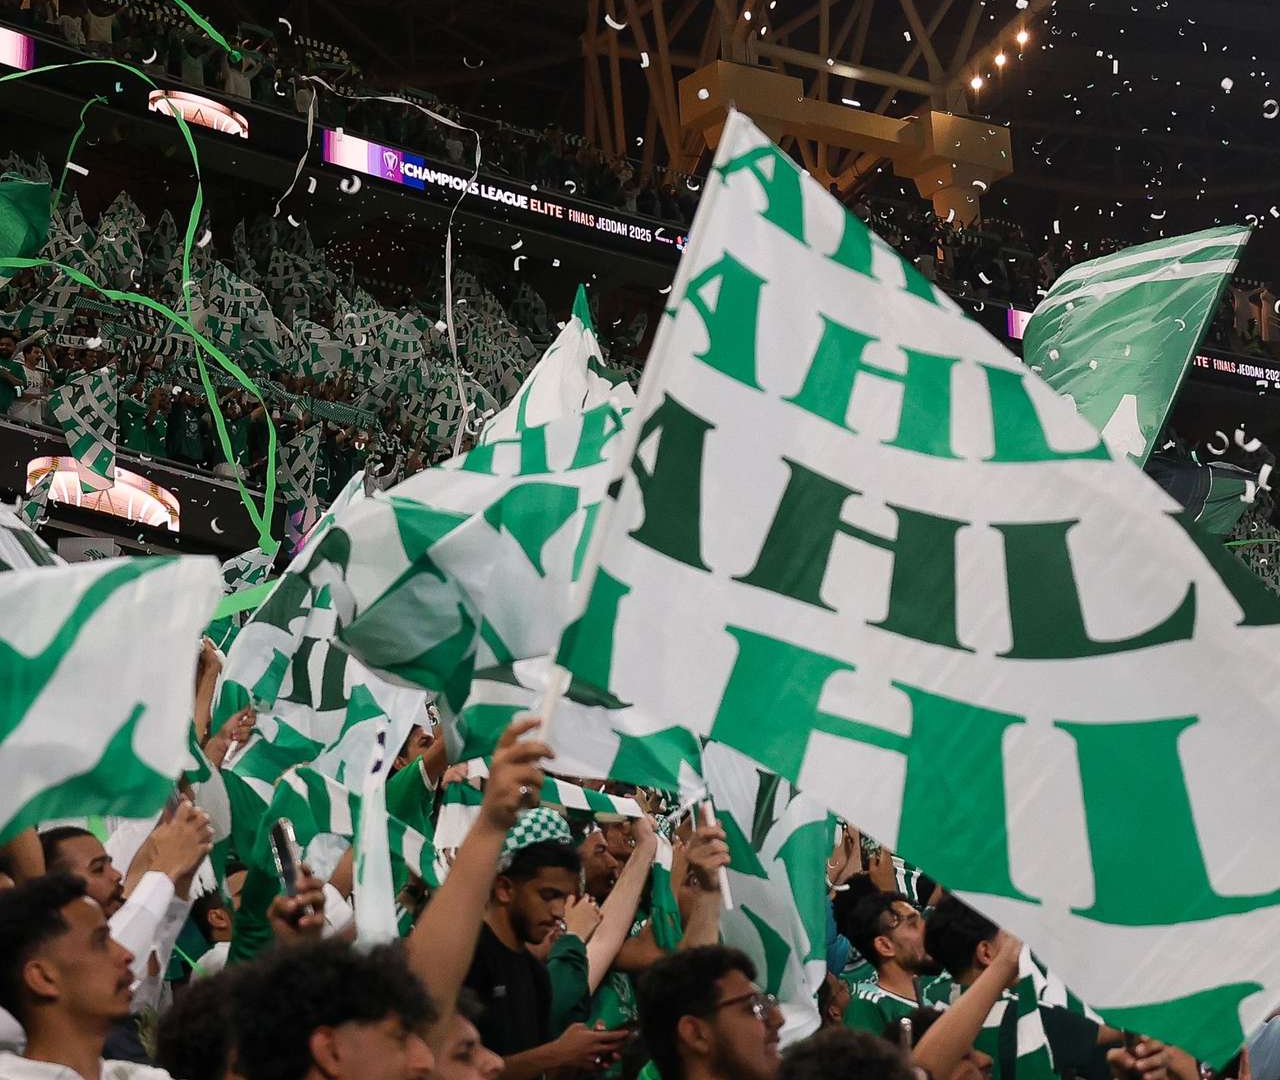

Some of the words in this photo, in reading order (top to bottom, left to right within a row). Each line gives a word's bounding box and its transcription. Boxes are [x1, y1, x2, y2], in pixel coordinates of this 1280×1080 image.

[404, 162, 480, 196] CHAMPIONS
[480, 183, 528, 210] LEAGUE
[530, 197, 563, 219] ELITE
[568, 208, 595, 228] FINALS
[596, 216, 628, 237] JEDDAH
[628, 225, 652, 243] 2025
[1213, 358, 1236, 373] FINALS
[1238, 363, 1265, 379] JEDDAH
